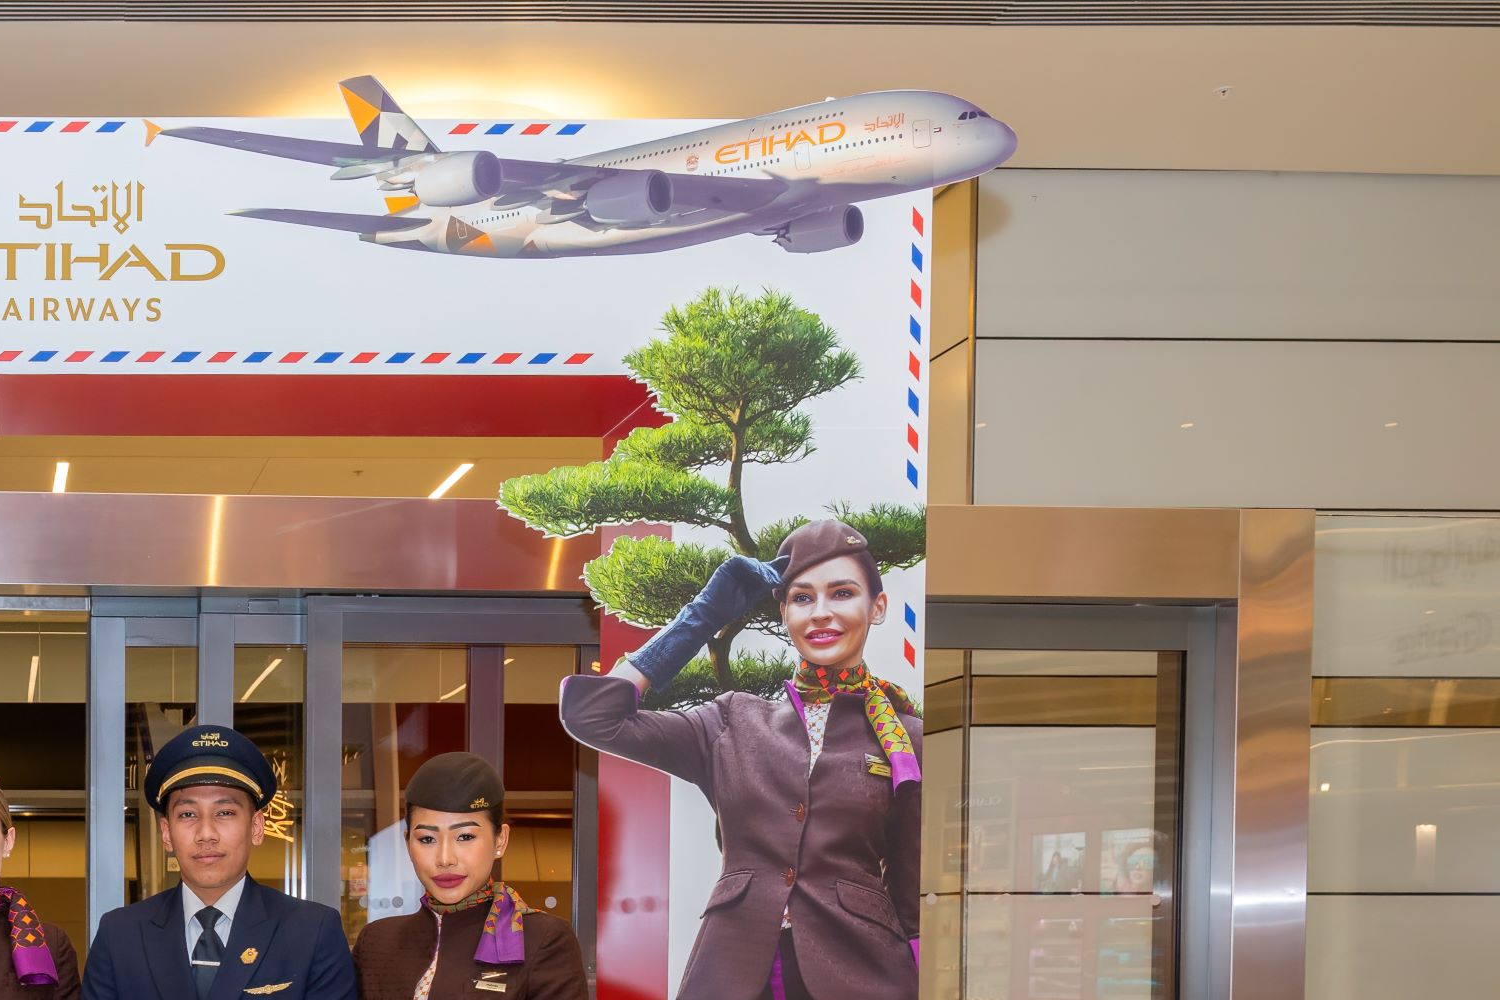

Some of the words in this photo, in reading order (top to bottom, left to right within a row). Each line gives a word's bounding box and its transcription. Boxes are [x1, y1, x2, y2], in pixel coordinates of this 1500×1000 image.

[714, 121, 847, 165] ETIHAD
[18, 180, 145, 235] الاتحاد
[1, 297, 162, 323] AIRWAYS
